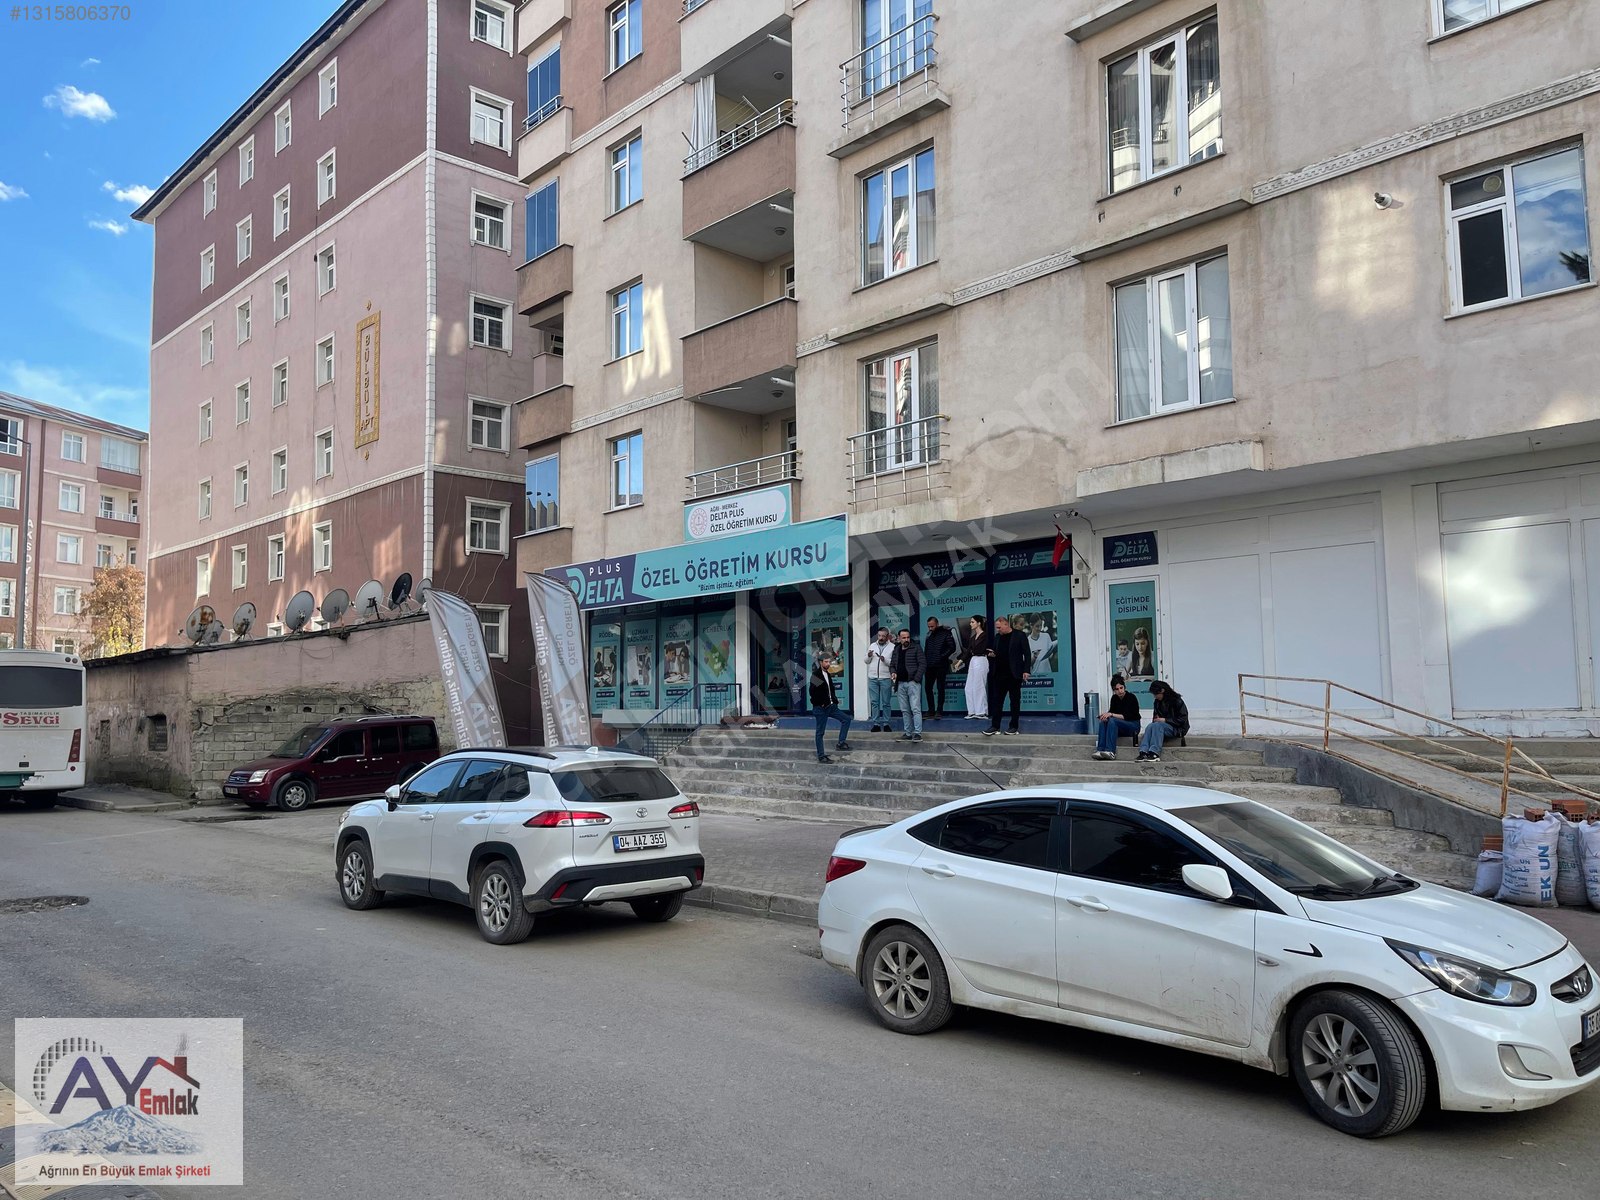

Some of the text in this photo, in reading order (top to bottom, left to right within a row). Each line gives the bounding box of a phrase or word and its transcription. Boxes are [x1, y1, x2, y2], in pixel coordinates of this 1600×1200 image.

[360, 417, 374, 432] APT
[722, 502, 738, 510] MERKEZ
[710, 508, 745, 522] DELTA PLUS
[710, 513, 778, 533] ÖZEL ÖĞRETİM KURSU
[1112, 541, 1150, 558] DELTA
[589, 562, 621, 576] PLUS
[641, 542, 827, 589] ÖZEL ÖĞRETİM KURSU
[998, 555, 1029, 570] DELTA
[923, 565, 950, 580] DELTA
[566, 567, 625, 605] DELTA
[939, 594, 984, 606] BİLGİLENDİRME
[1018, 591, 1044, 599] SOSYAL
[1115, 595, 1150, 605] EĞİTİMDE
[940, 603, 965, 613] SİSTEMİ
[1010, 597, 1053, 609] ETKİNLİKLER
[1118, 605, 1149, 614] DİSİPLİN
[620, 834, 665, 848] 04 AAZ 355
[1538, 845, 1551, 871] UN
